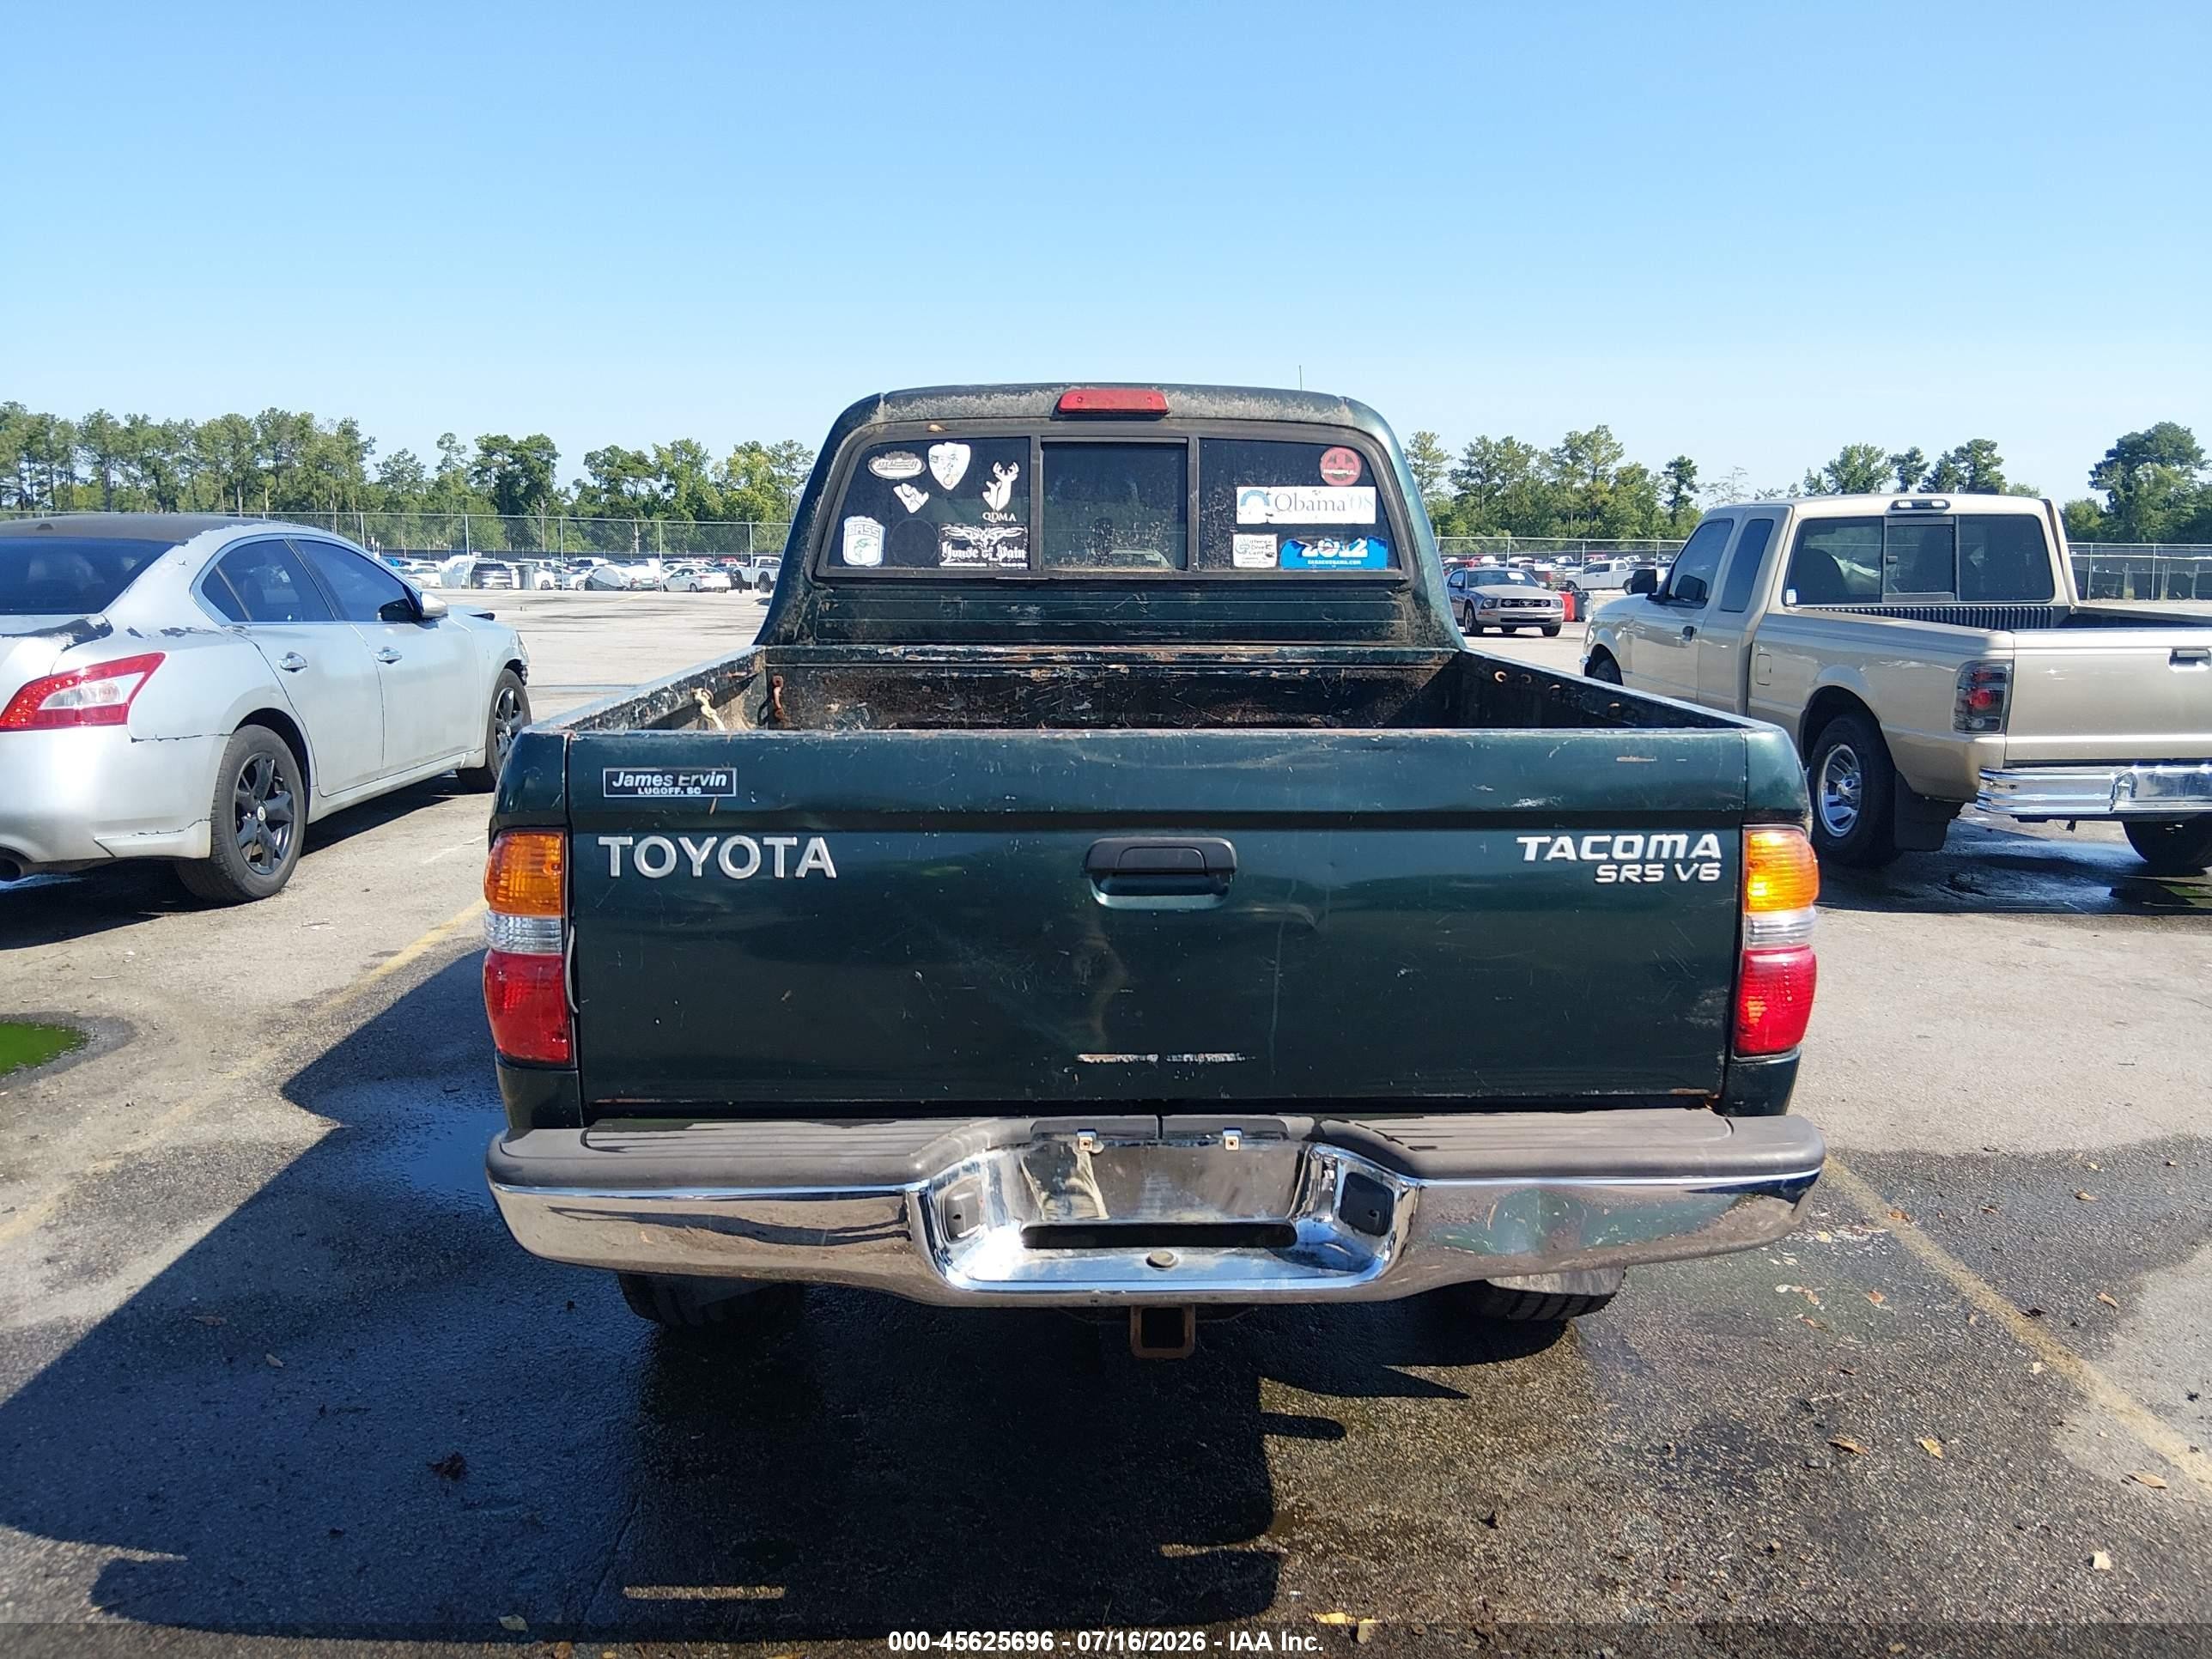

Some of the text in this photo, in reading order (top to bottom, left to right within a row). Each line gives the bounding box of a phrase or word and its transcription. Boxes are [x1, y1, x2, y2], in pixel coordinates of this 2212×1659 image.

[1274, 491, 1346, 512] Obama
[981, 511, 1018, 523] QDMA
[848, 523, 880, 537] BASS
[995, 542, 1027, 562] Pain
[611, 771, 727, 787] James Ervin
[686, 787, 702, 795] SC
[598, 835, 837, 879] TOYOTA
[1516, 833, 1723, 861] TACOMA
[1594, 861, 1723, 884] SR5 V6
